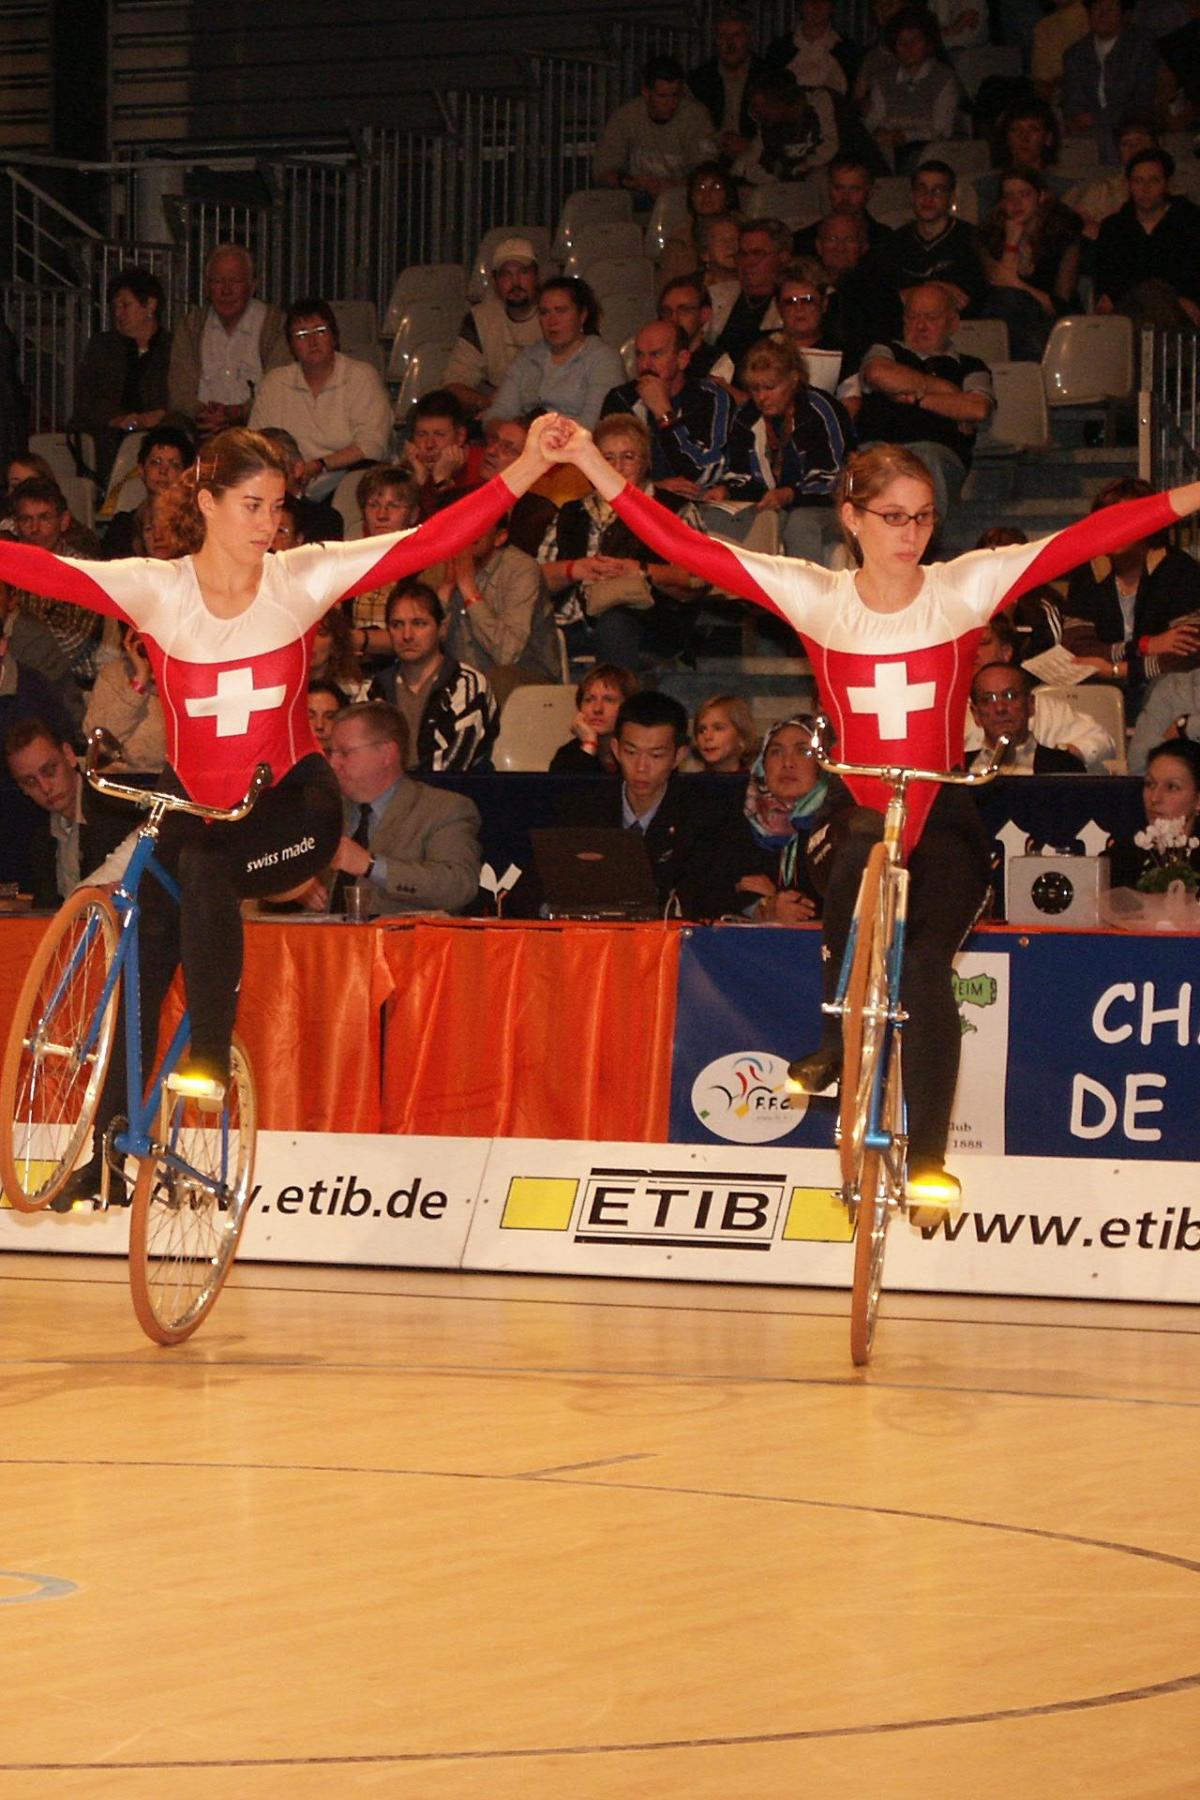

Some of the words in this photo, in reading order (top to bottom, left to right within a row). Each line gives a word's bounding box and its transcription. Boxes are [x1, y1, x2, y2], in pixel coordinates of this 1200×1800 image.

[246, 852, 279, 873] swiss
[282, 836, 316, 861] made
[1092, 980, 1200, 1047] CH
[949, 1121, 972, 1132] lub
[1070, 1072, 1167, 1142] DE
[588, 1187, 770, 1231] ETIB
